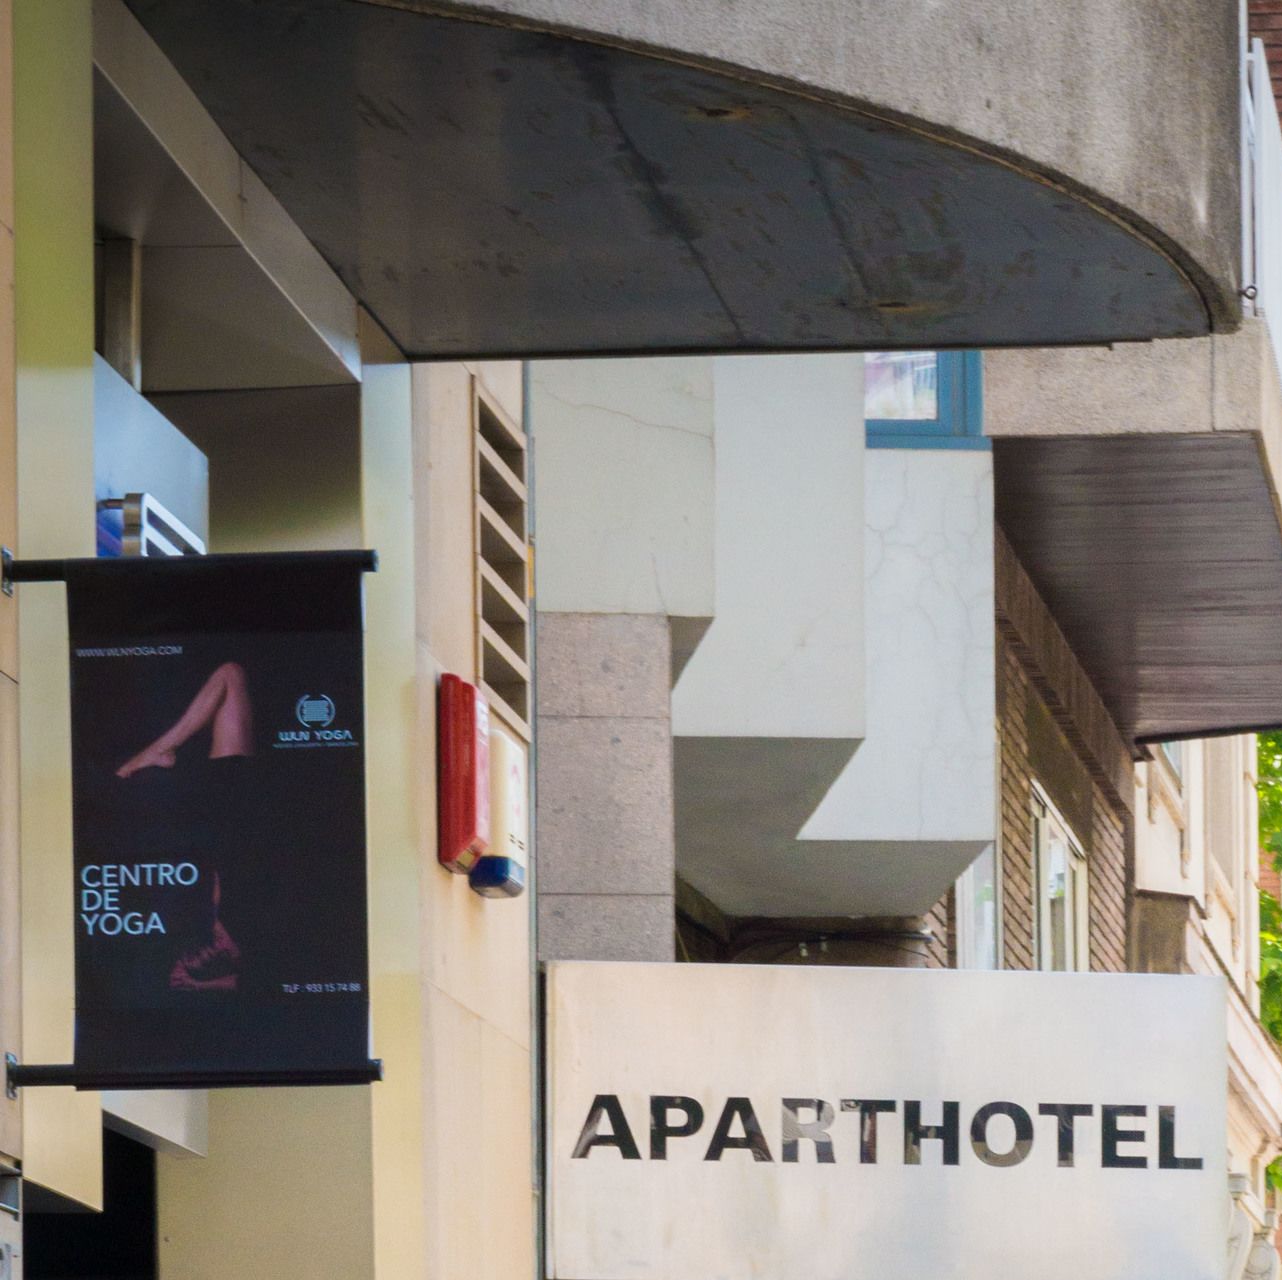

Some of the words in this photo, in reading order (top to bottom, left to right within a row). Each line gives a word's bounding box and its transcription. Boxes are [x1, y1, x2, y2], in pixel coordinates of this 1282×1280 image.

[314, 729, 353, 741] YOGA
[81, 862, 199, 888] CENTRO
[81, 889, 120, 911] DE
[80, 911, 167, 936] YOGA
[571, 1093, 1205, 1171] APARTHOTEL
